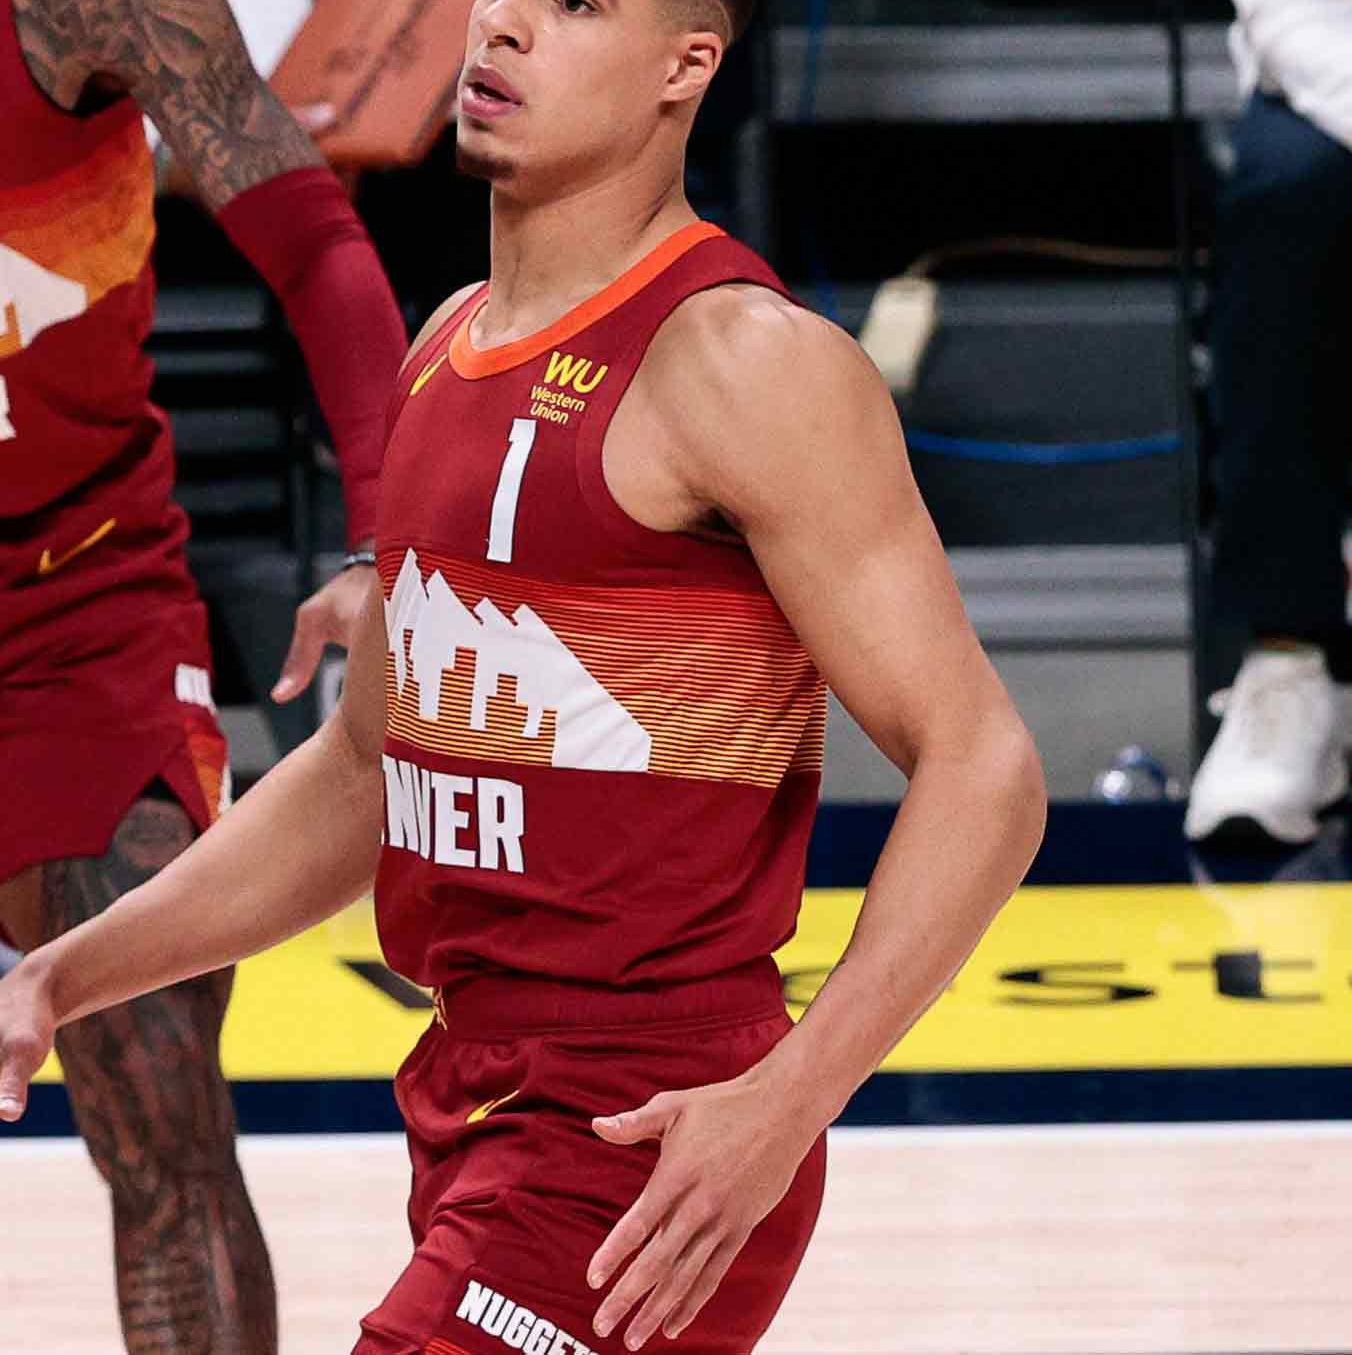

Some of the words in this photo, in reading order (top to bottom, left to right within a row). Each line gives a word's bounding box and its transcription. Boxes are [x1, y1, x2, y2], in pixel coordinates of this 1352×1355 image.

[544, 351, 608, 393] WU
[531, 385, 586, 412] Western
[531, 402, 569, 424] Union
[486, 417, 538, 564] 1
[381, 752, 526, 874] NVER
